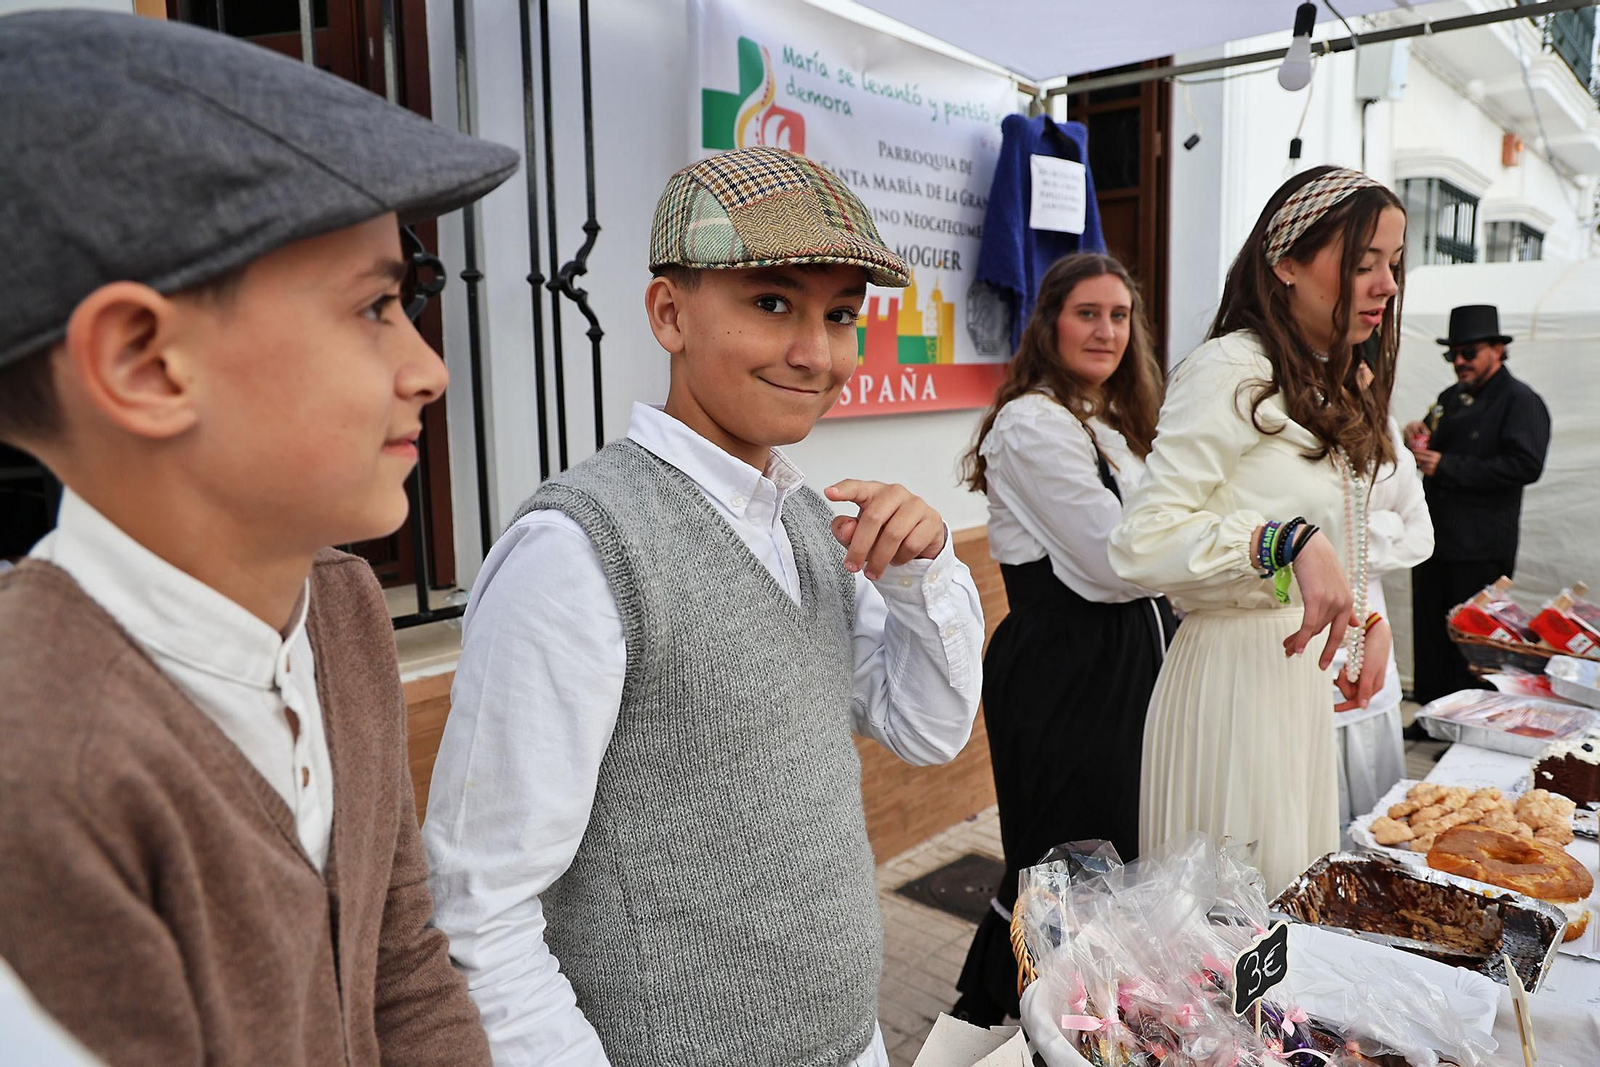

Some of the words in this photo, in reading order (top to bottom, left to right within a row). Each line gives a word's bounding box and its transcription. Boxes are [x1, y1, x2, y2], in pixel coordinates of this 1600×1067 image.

[782, 44, 830, 79] María
[838, 67, 855, 88] se
[928, 97, 938, 122] y
[944, 101, 990, 126] partió
[786, 74, 853, 117] demora
[877, 140, 958, 172] PARROQUIA
[959, 159, 974, 175] DE
[872, 172, 923, 195] MARÍA
[926, 183, 942, 200] DE
[945, 187, 958, 204] LA
[871, 206, 901, 225] INO
[896, 240, 962, 271] MOGUER
[1242, 940, 1282, 996] 3€
